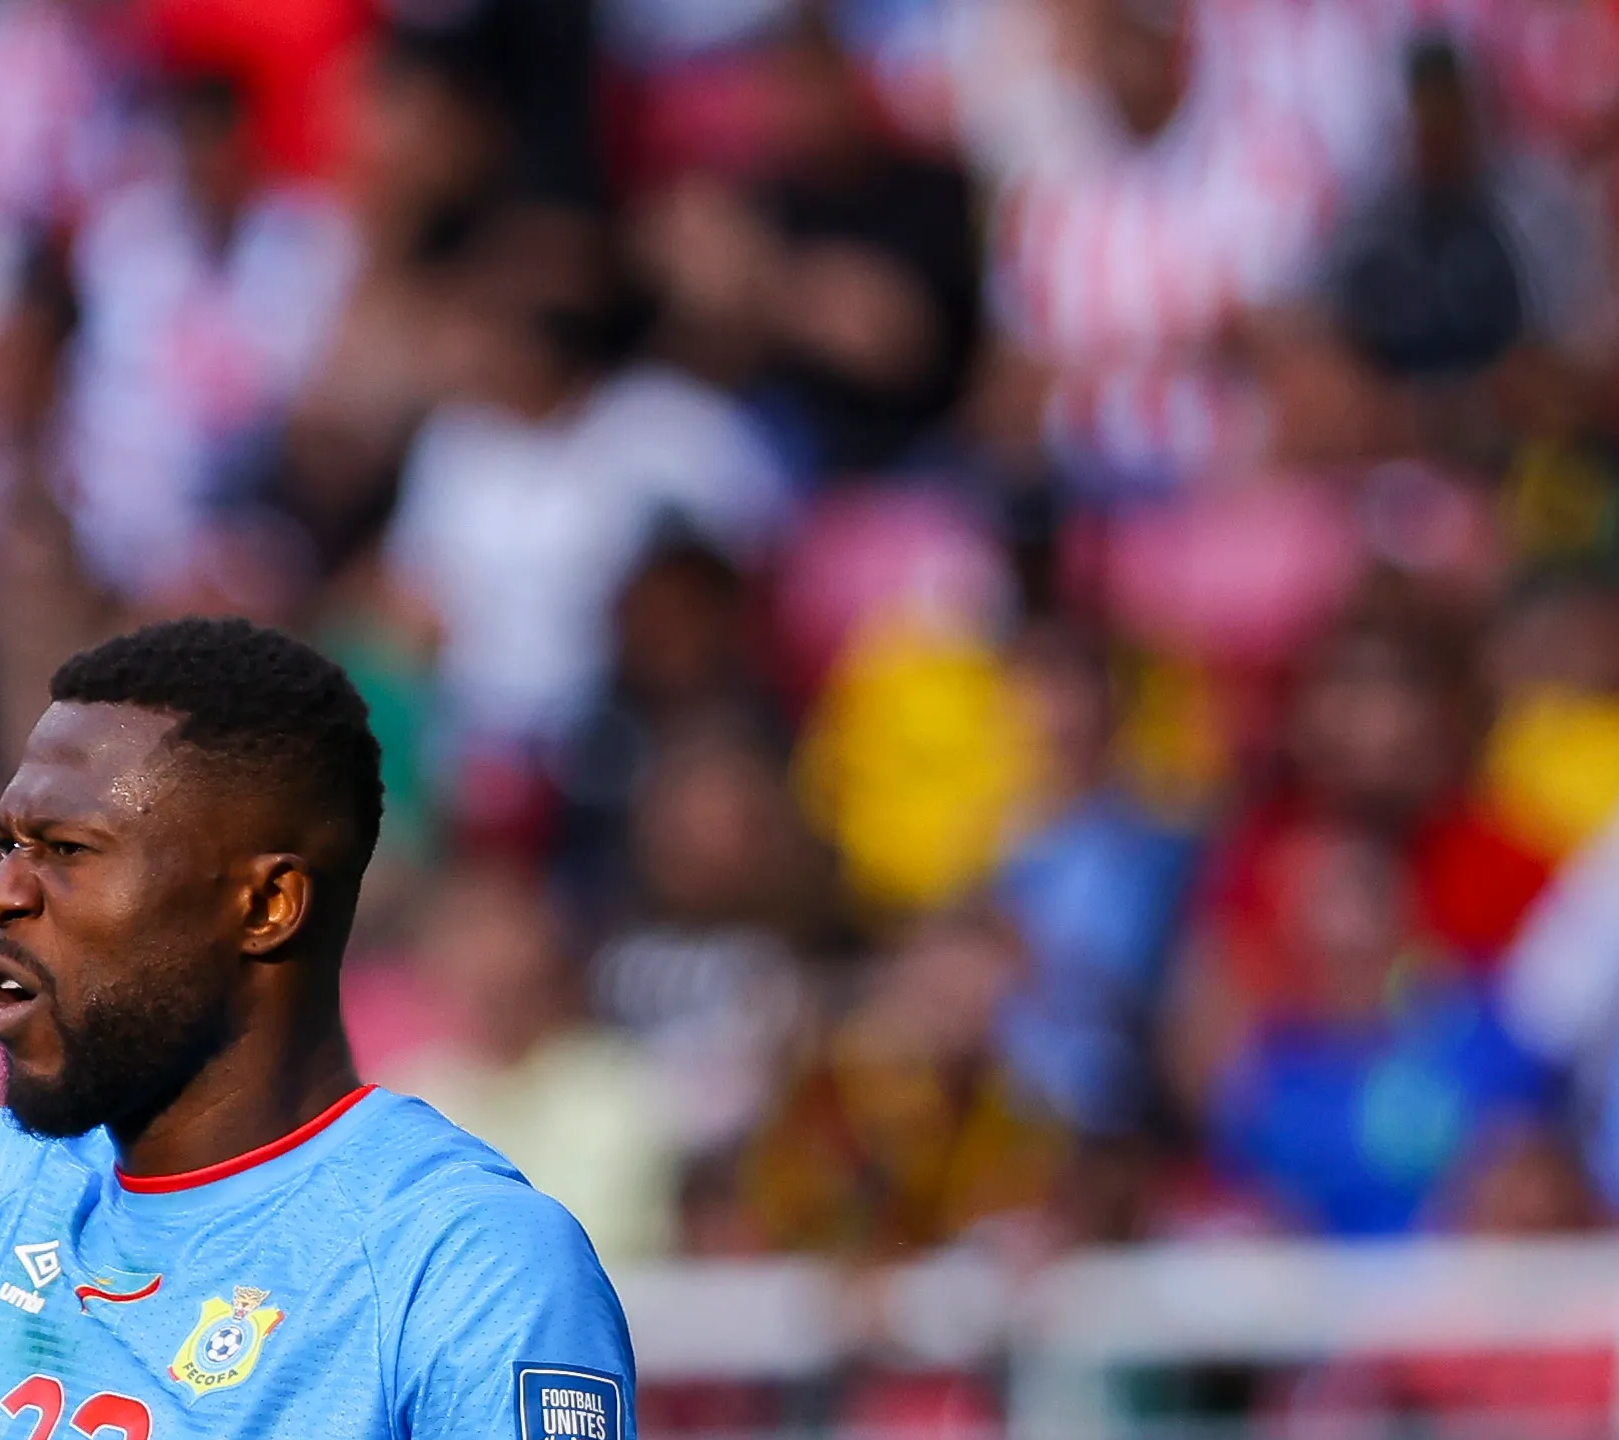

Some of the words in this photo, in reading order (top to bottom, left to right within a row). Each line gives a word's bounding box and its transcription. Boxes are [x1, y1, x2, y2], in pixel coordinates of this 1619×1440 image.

[182, 1361, 239, 1386] FECOFA
[541, 1388, 604, 1415] FOOTBALL
[543, 1409, 606, 1440] UNITES
